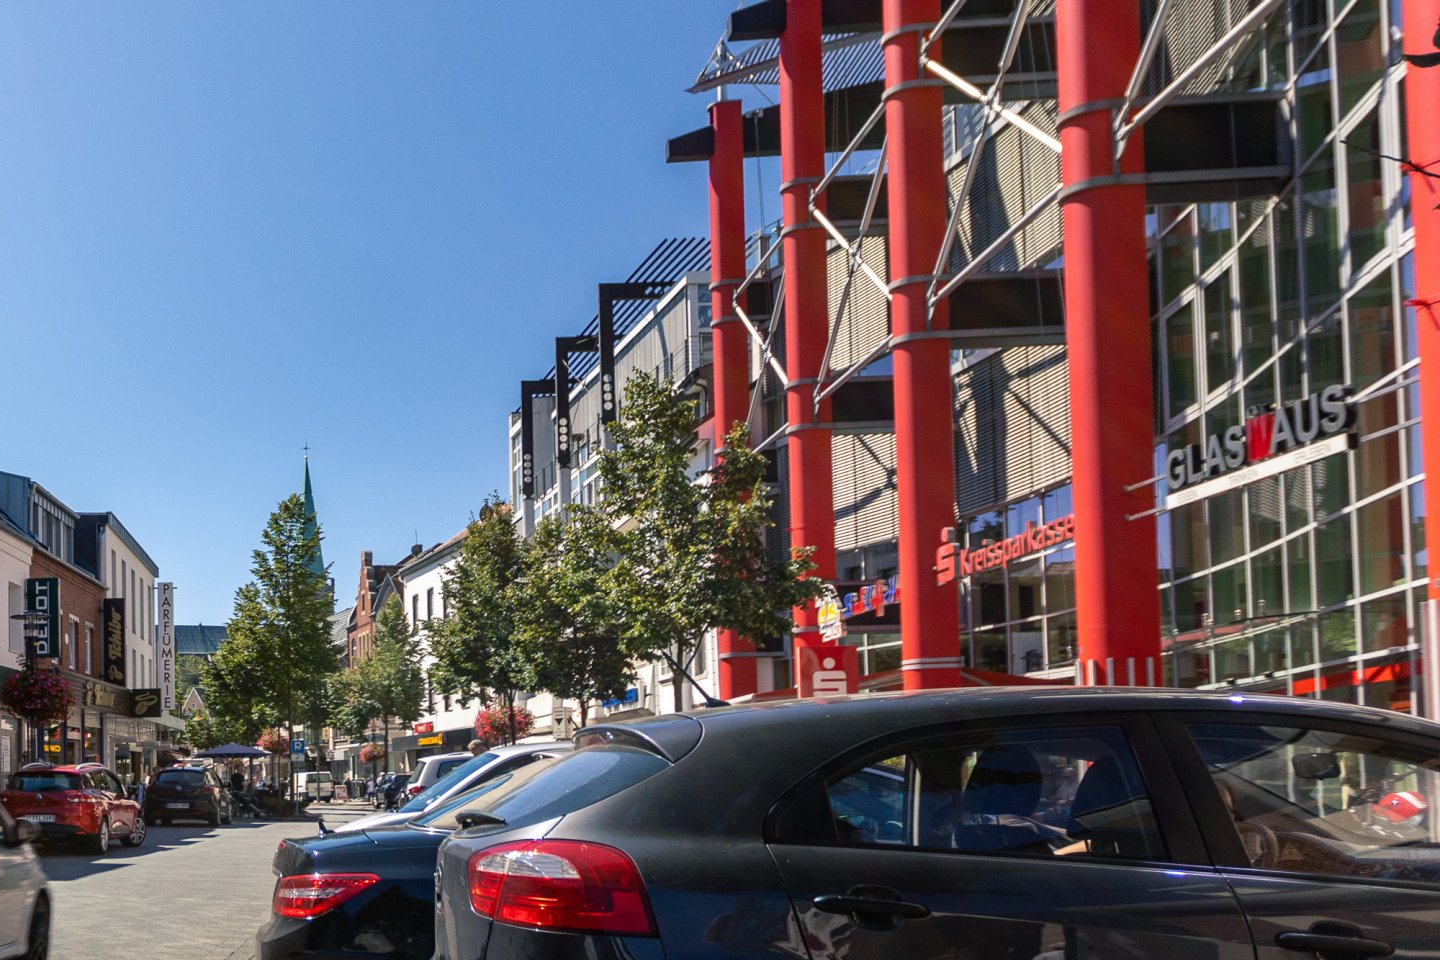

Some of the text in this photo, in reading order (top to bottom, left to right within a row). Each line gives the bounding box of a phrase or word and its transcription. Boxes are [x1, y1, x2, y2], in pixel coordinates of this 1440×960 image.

[961, 514, 1075, 576] Kreissparkasse
[108, 606, 122, 660] Tchibo
[161, 583, 172, 709] PARFÜMERIE
